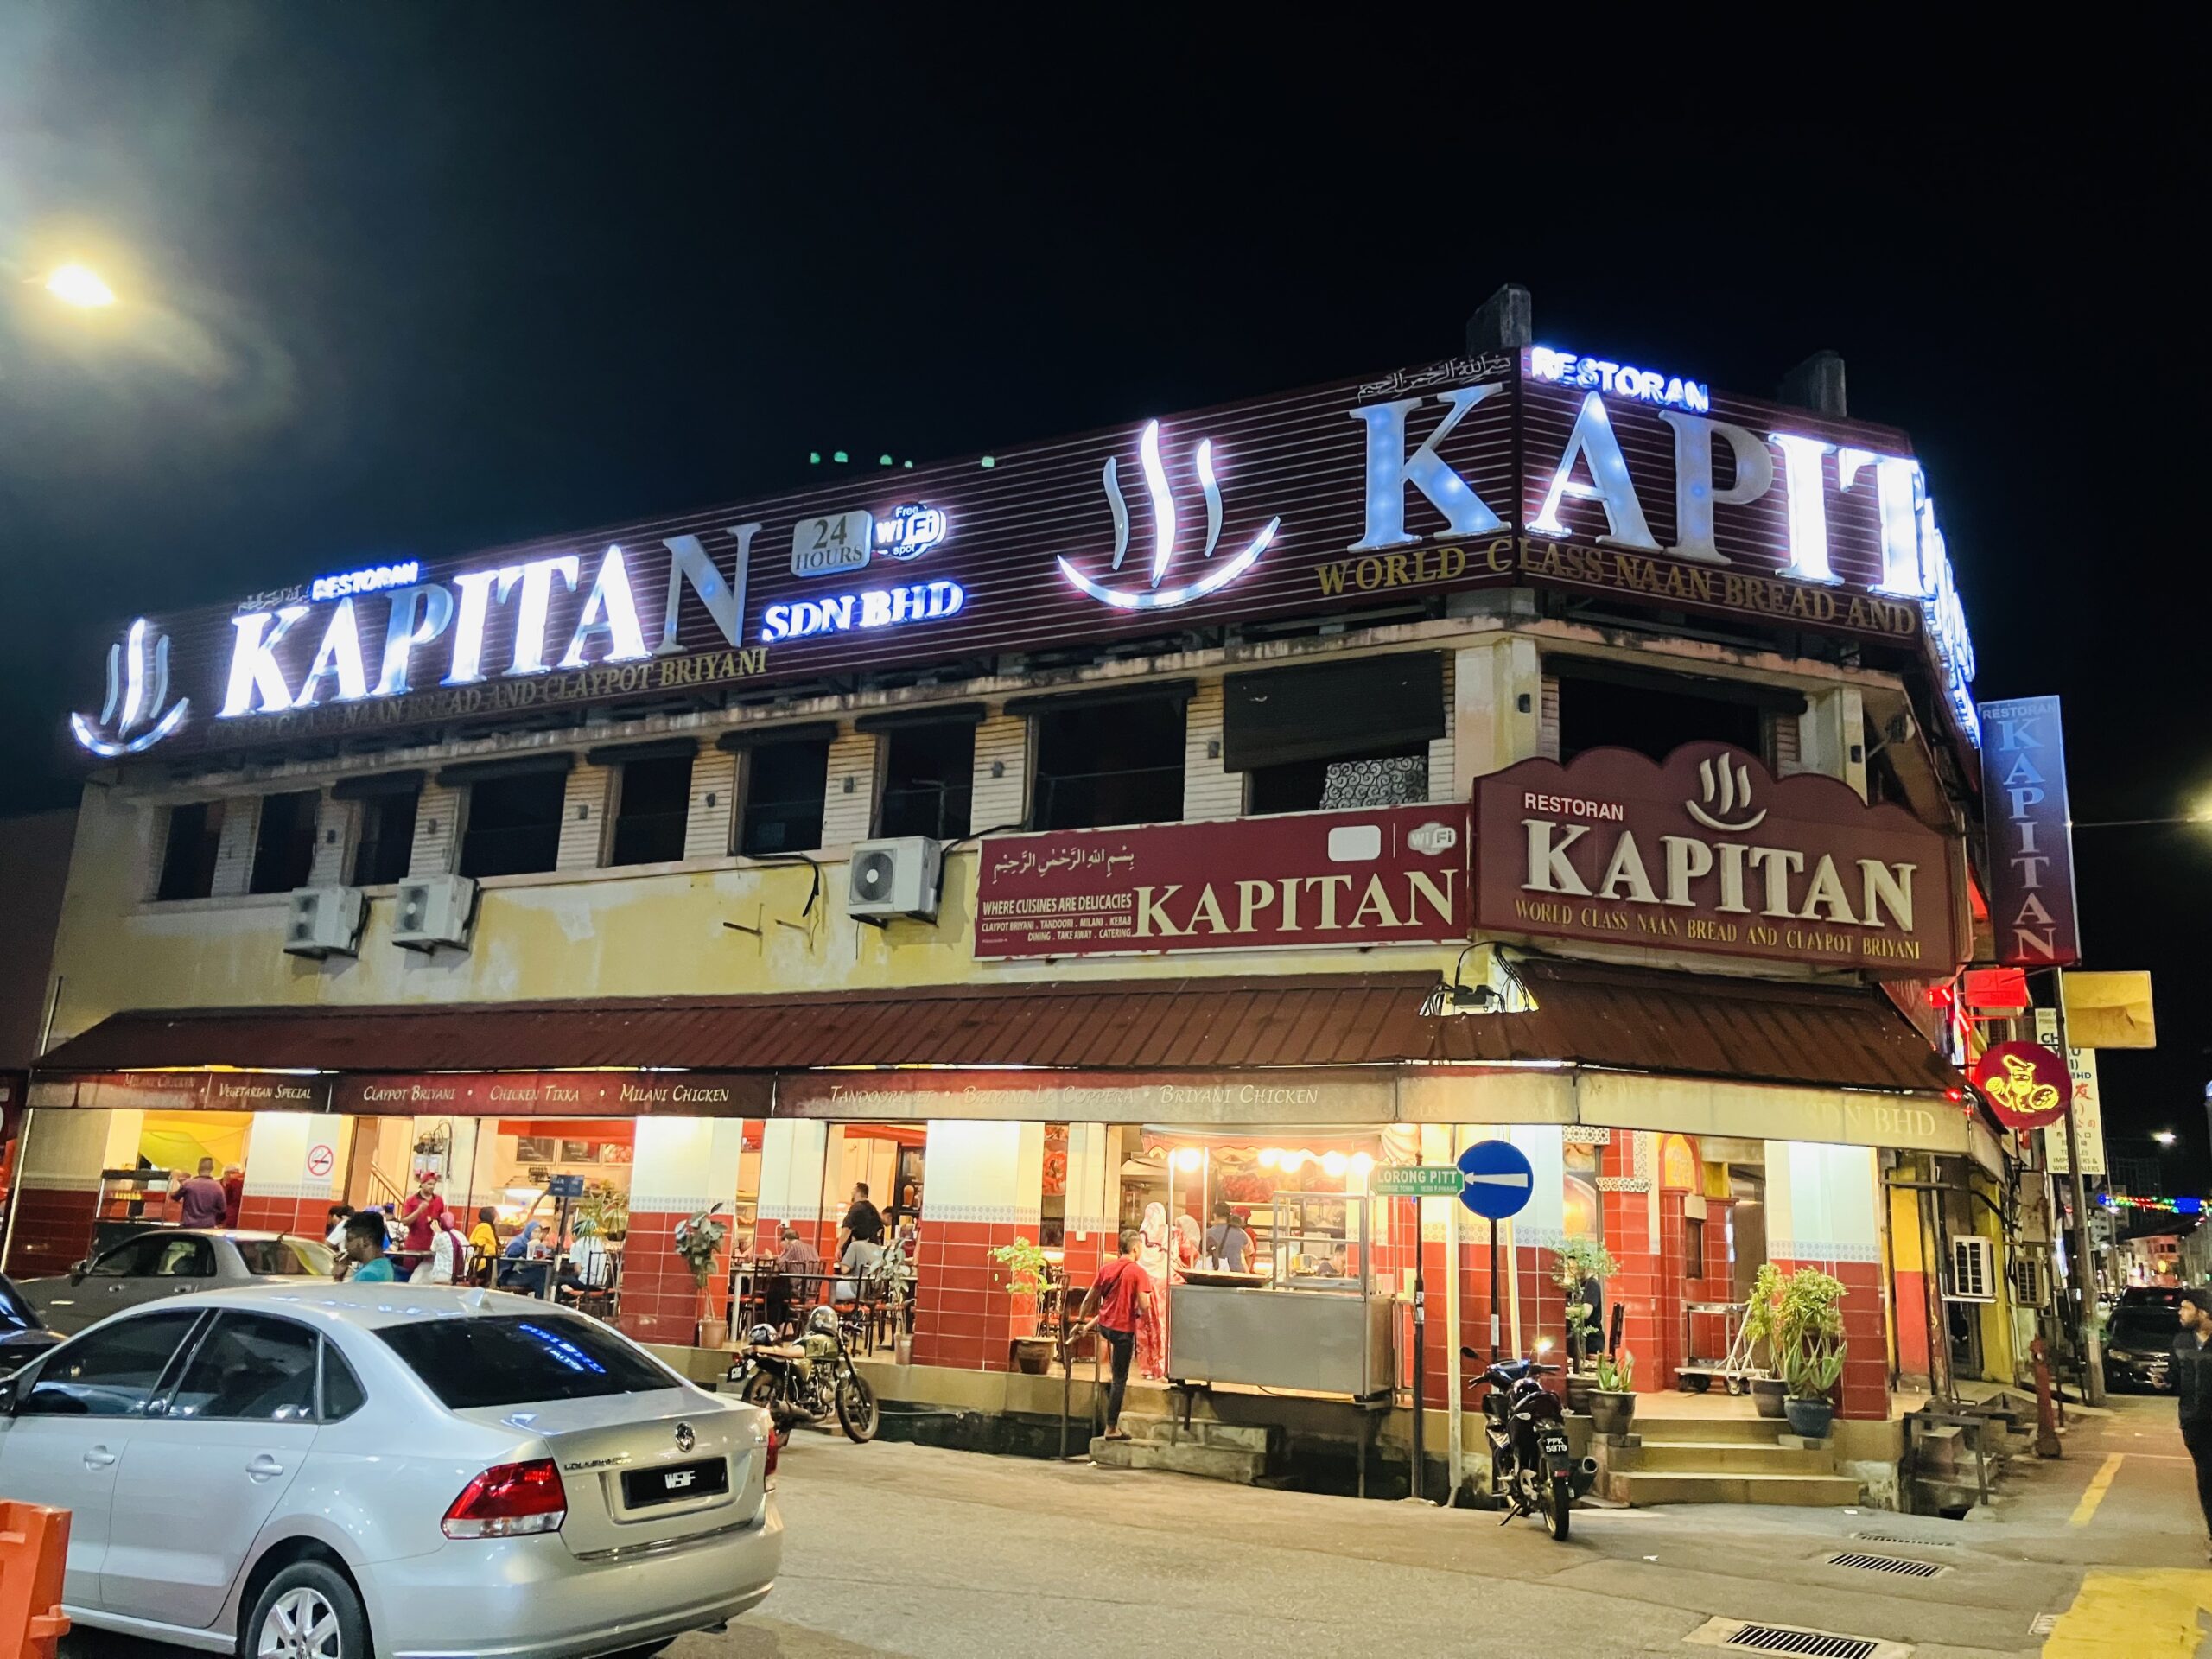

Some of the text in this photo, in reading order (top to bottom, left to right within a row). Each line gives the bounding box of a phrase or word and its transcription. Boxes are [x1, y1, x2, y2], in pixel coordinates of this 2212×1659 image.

[1531, 346, 1709, 413] RESTORAN
[895, 506, 919, 518] Free
[812, 515, 848, 550] 24
[795, 544, 864, 571] HOURS
[893, 543, 916, 556] spot
[312, 561, 419, 601] RESTORAN
[1315, 537, 1916, 636] WORLD CLASS NAAN BREAD AND
[215, 523, 763, 718] KAPITAN
[761, 580, 965, 644] SDN BHD
[485, 682, 537, 709] AND
[543, 663, 654, 702] CLAYPOT
[658, 647, 769, 687] BRIYANI
[1982, 702, 2056, 720] RESTORAN
[1524, 792, 1624, 823] RESTORAN
[1995, 717, 2059, 962] KAPITAN
[1519, 817, 1918, 933] KAPITAN
[982, 893, 1133, 917] WHERE CUISINES ARE DELICACIES
[1131, 868, 1459, 938] KAPITAN
[982, 915, 1133, 932] CLAYPOT BRIYANI TANDOORI MILANI KEBAB
[1027, 928, 1132, 942] DINING TAKE AWAY CATERING
[1515, 899, 1922, 960] WORLD CLASS NAAN BREAD AND CLAYPOT BRIYANI
[219, 1082, 274, 1099] VEGETARIAN
[274, 1084, 313, 1100] SPECIAL
[363, 1084, 730, 1103] CLAYPOT BRIYANI CHICKEN TIKKA MILANI CHICKEN
[830, 1085, 906, 1103] TANDOORI
[1160, 1084, 1232, 1104] BRIYANI
[1239, 1084, 1319, 1104] CHICKEN
[1872, 1107, 1936, 1136] BHD
[1377, 1170, 1458, 1184] LORONG PITT
